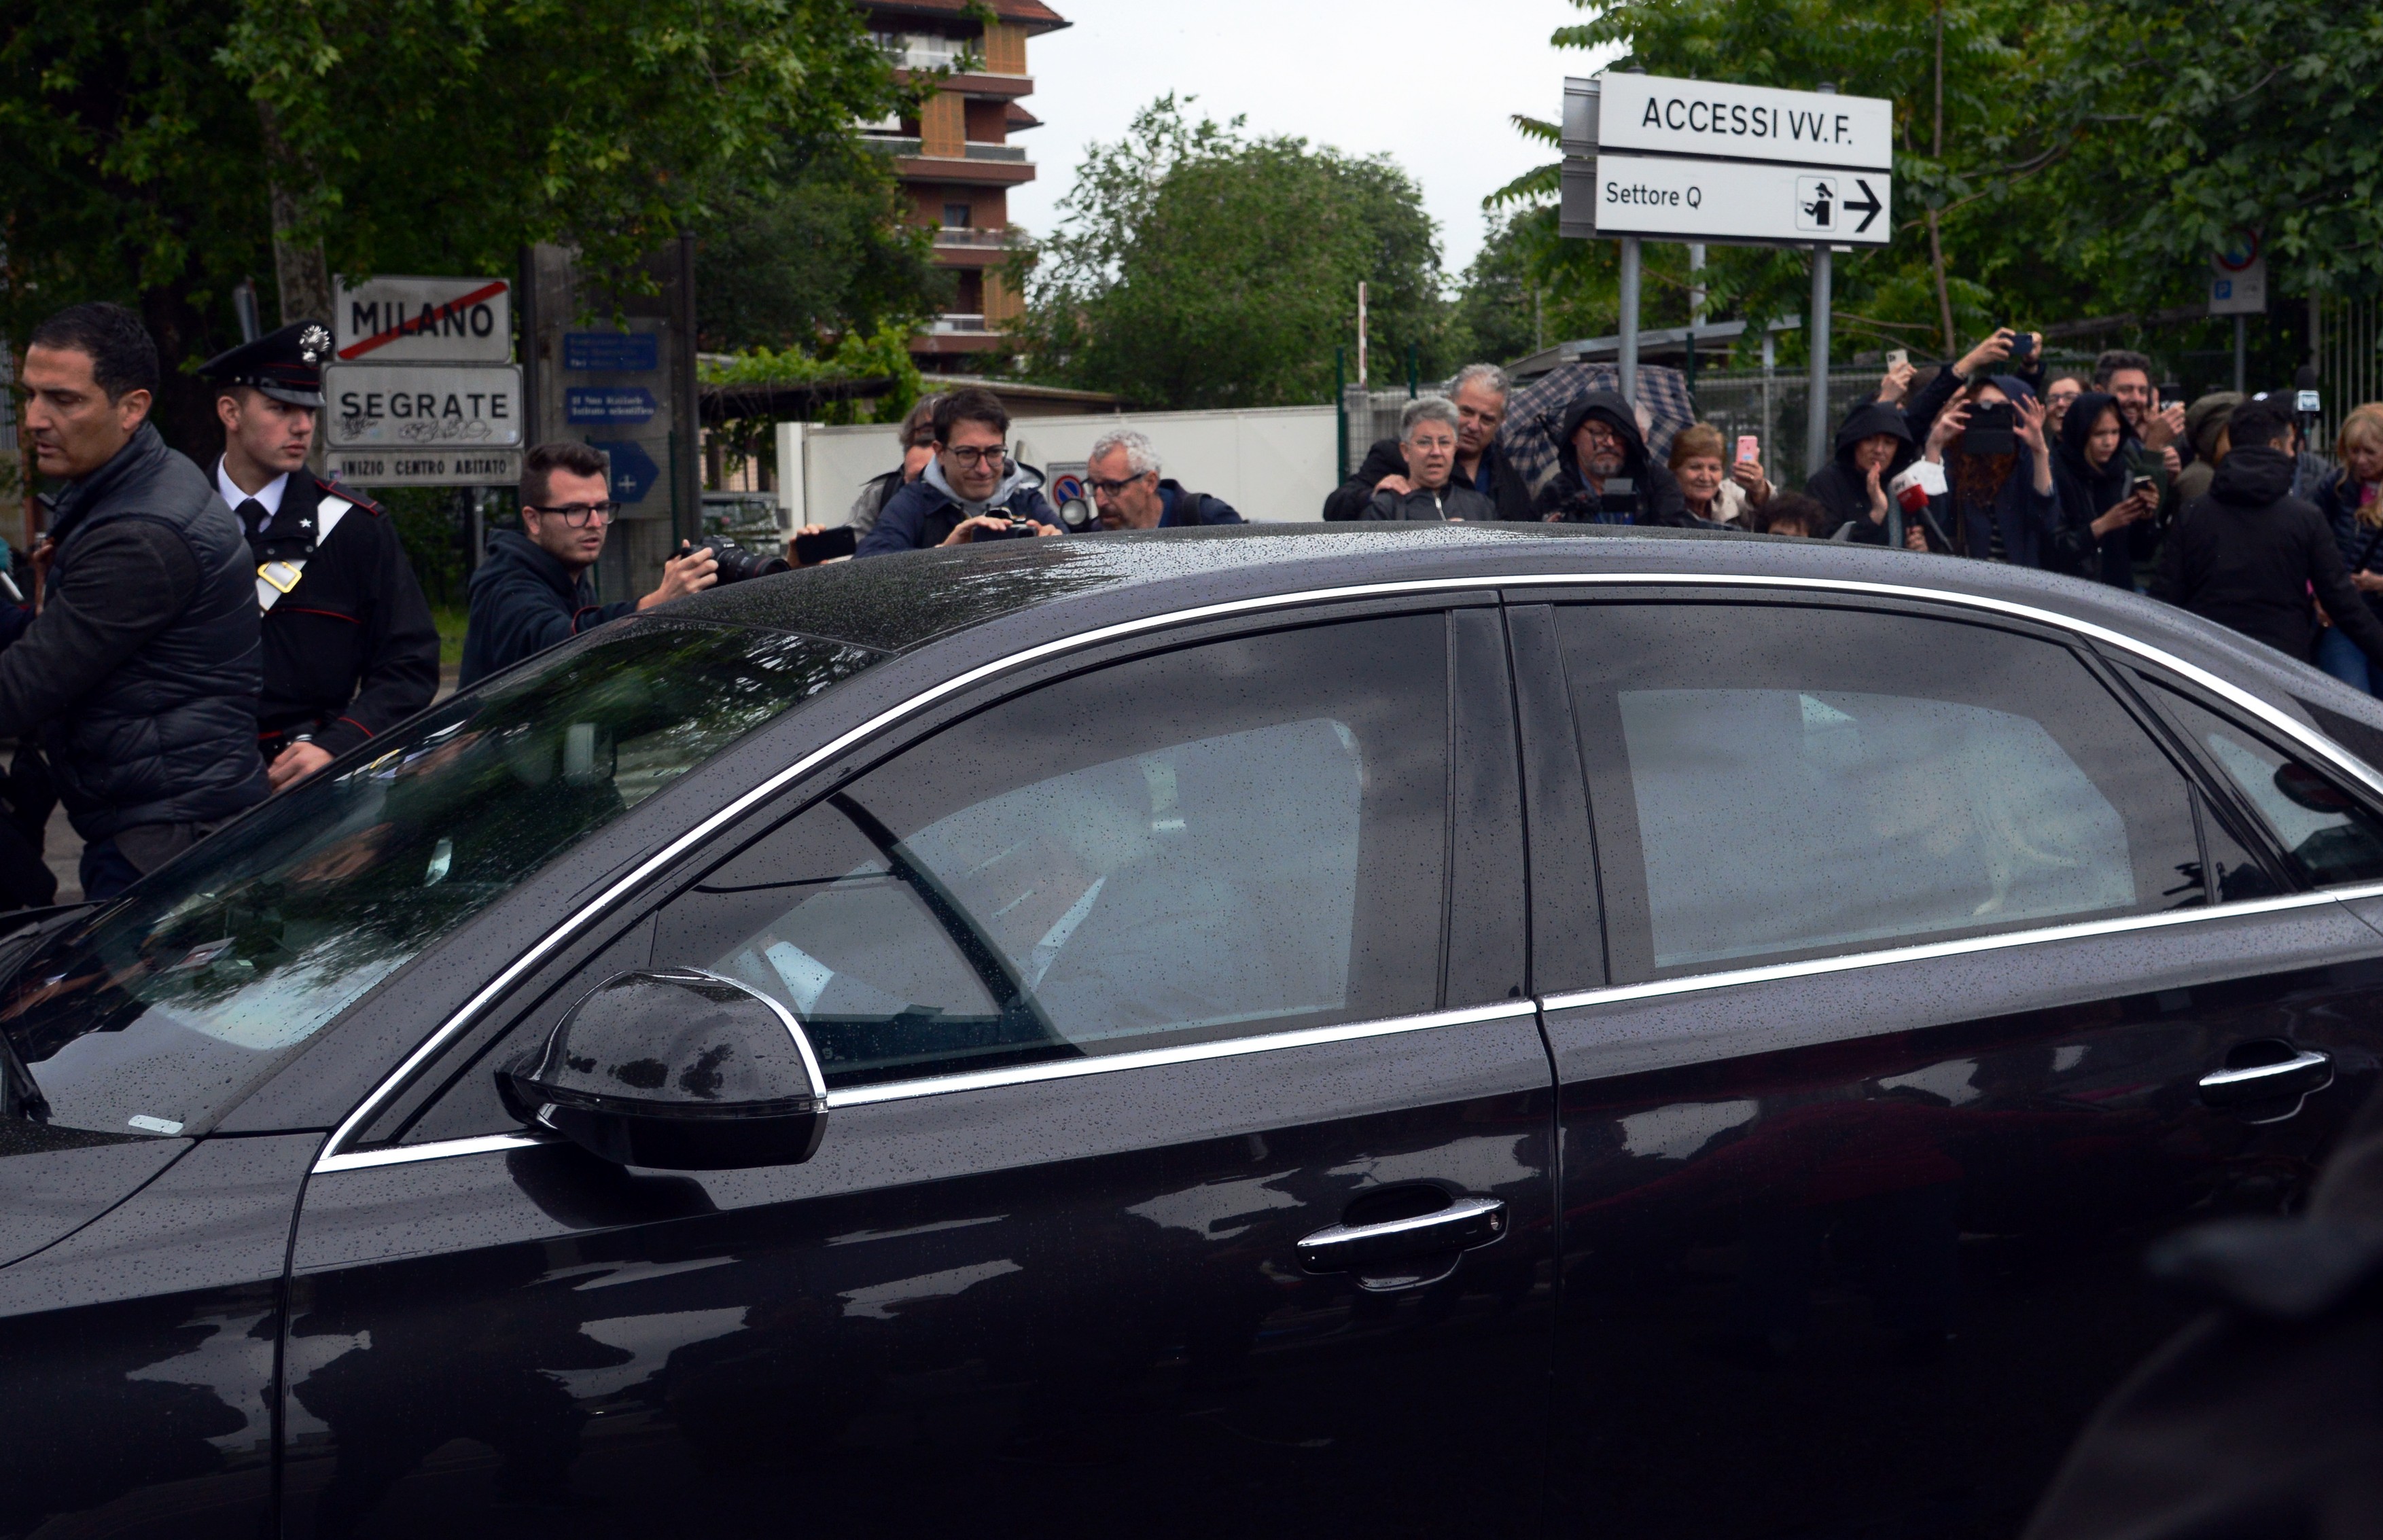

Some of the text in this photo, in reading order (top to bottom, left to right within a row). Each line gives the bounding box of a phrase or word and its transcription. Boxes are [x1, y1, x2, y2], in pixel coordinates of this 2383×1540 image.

[1642, 97, 1778, 139] ACCESSI
[1606, 181, 1702, 210] Settore Q
[351, 301, 494, 338] MILANO
[341, 392, 509, 419] SEGRATE
[342, 459, 507, 475] INIZIO CENTRO ABITATO
